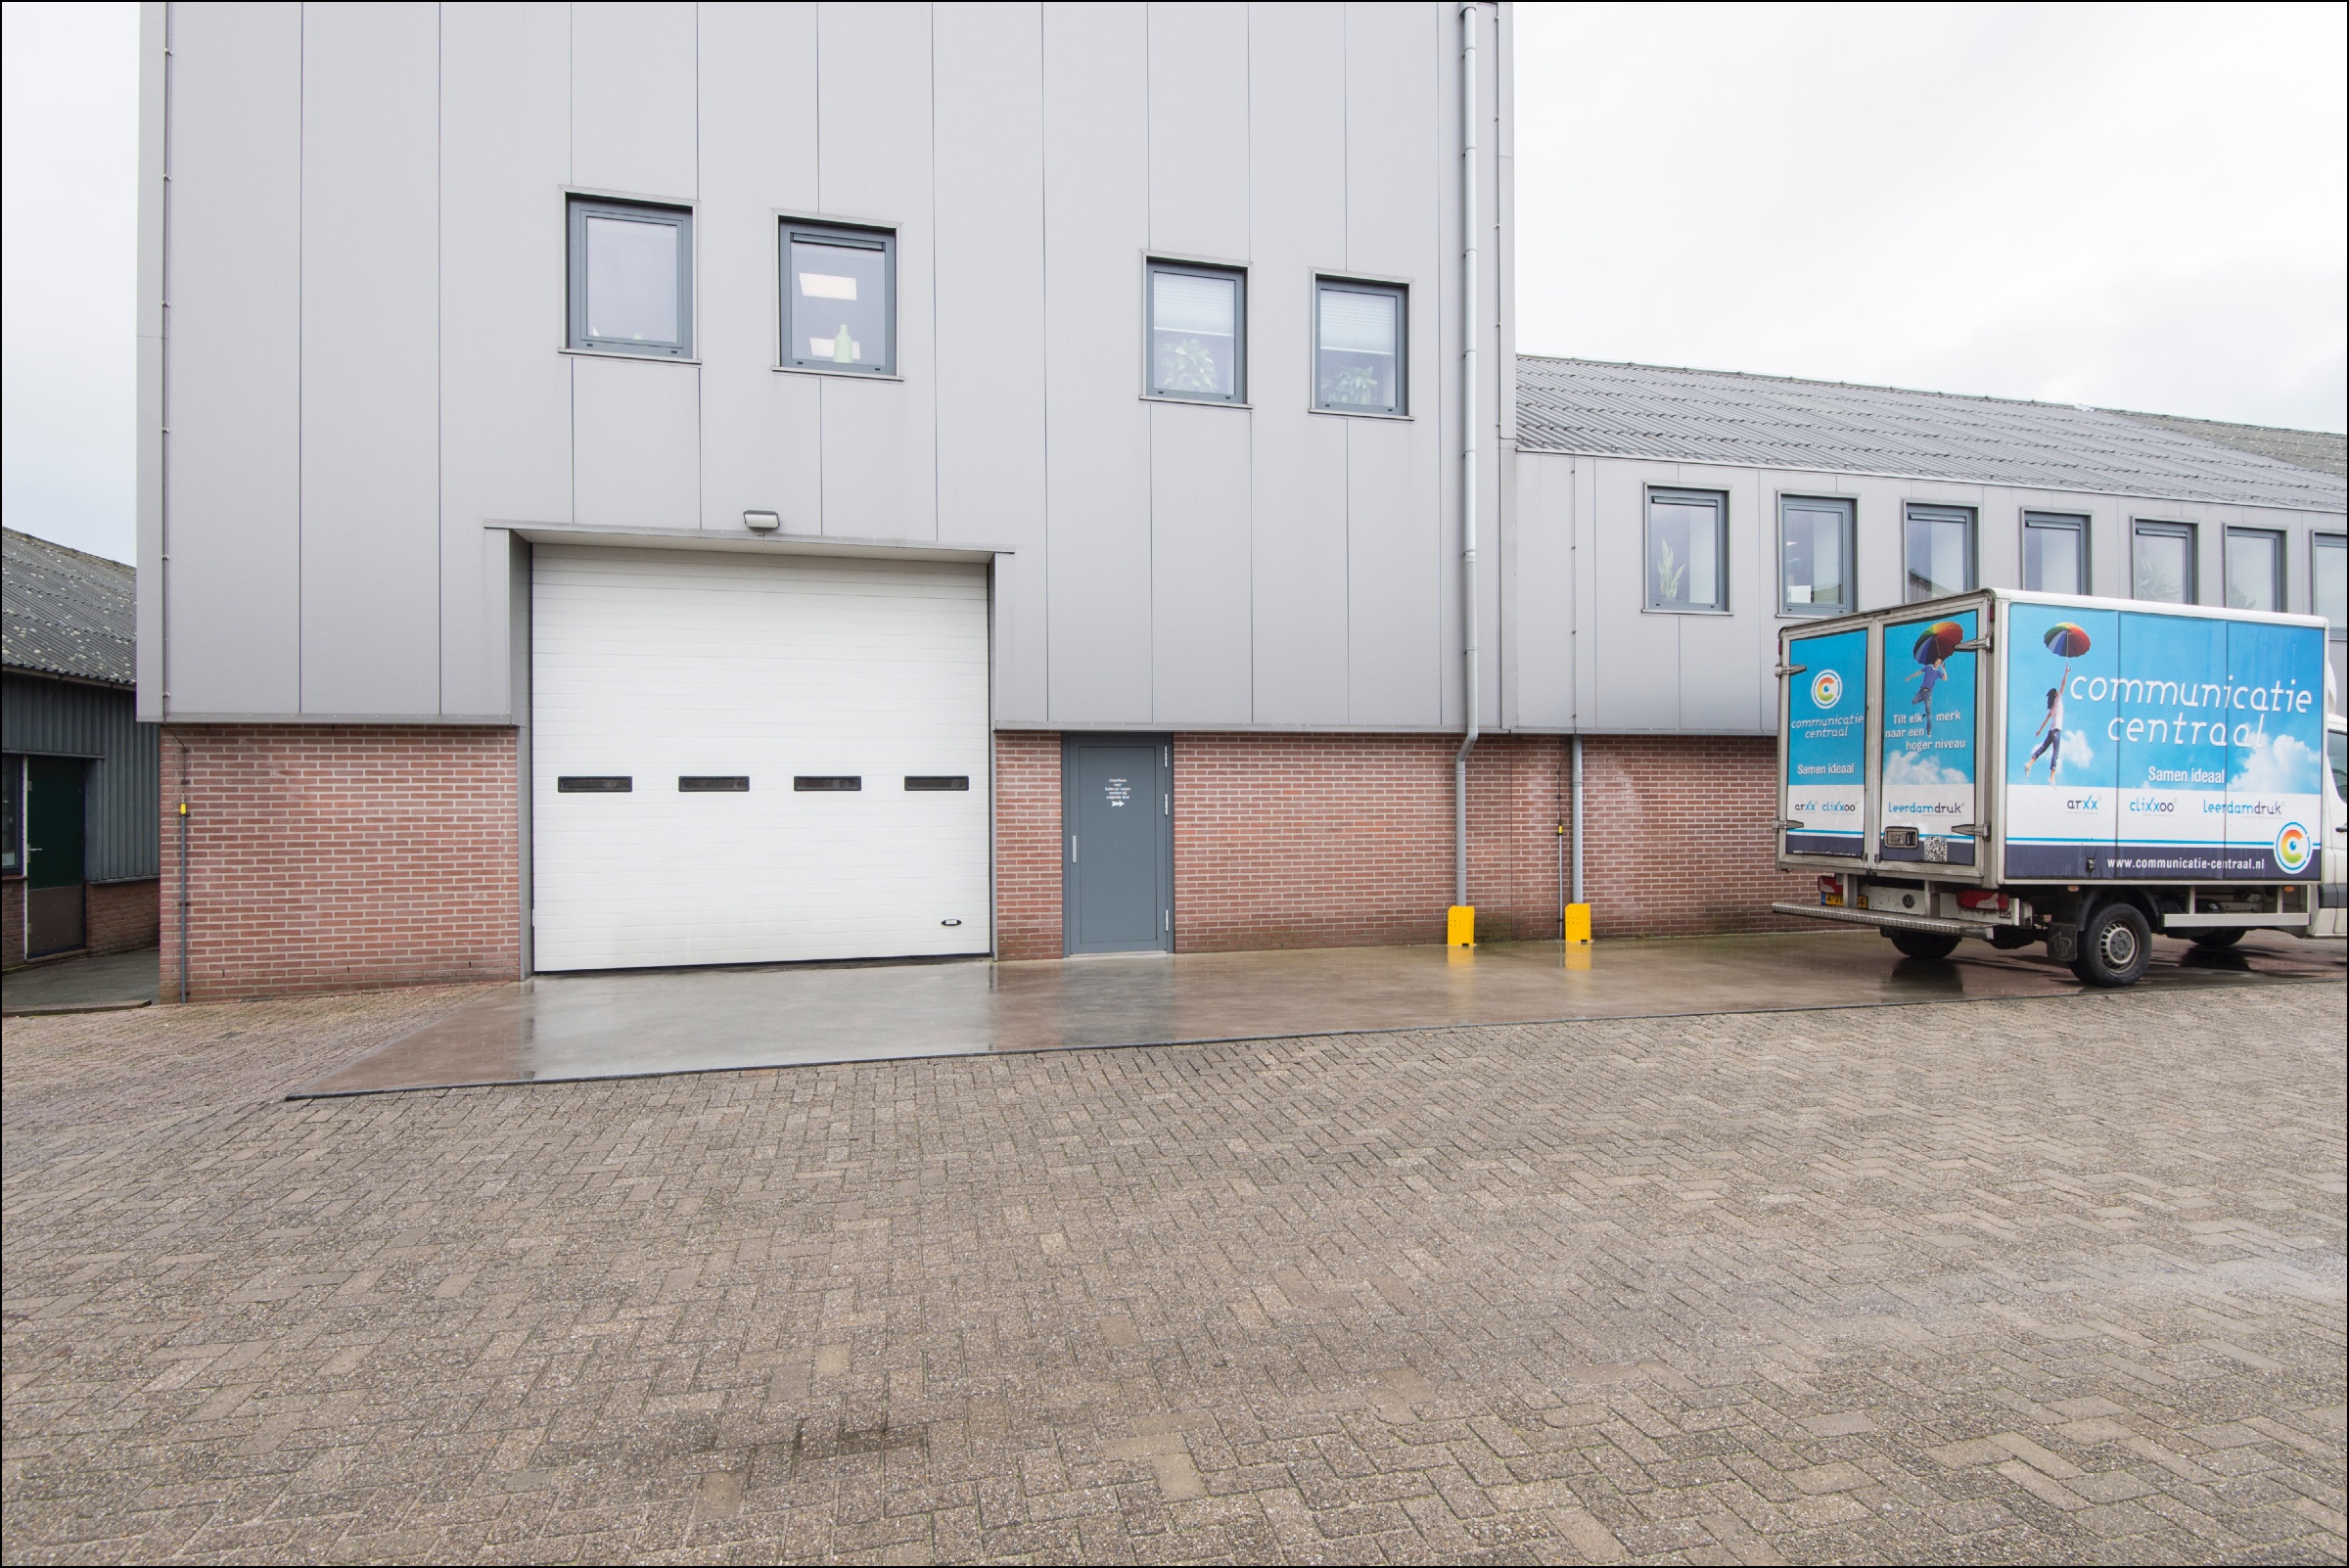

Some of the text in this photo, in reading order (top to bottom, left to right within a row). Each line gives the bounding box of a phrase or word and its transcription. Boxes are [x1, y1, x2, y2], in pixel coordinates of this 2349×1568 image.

[2069, 674, 2313, 714] communicatie
[1791, 713, 1865, 729] communicatie
[1893, 711, 1961, 724] Tilt elk merk
[1805, 725, 1849, 739] centraal
[1885, 728, 1924, 738] naar een
[2107, 712, 2266, 749] centraal
[1906, 739, 1966, 753] hoger niveau
[1797, 763, 1855, 775] Samen ideaal
[2148, 765, 2226, 784] Samen ideaal
[1888, 802, 1962, 813] leerdamdruk
[2203, 799, 2282, 814] leerdamdruk
[2106, 857, 2265, 870] www.communicatie-centraal.nl
